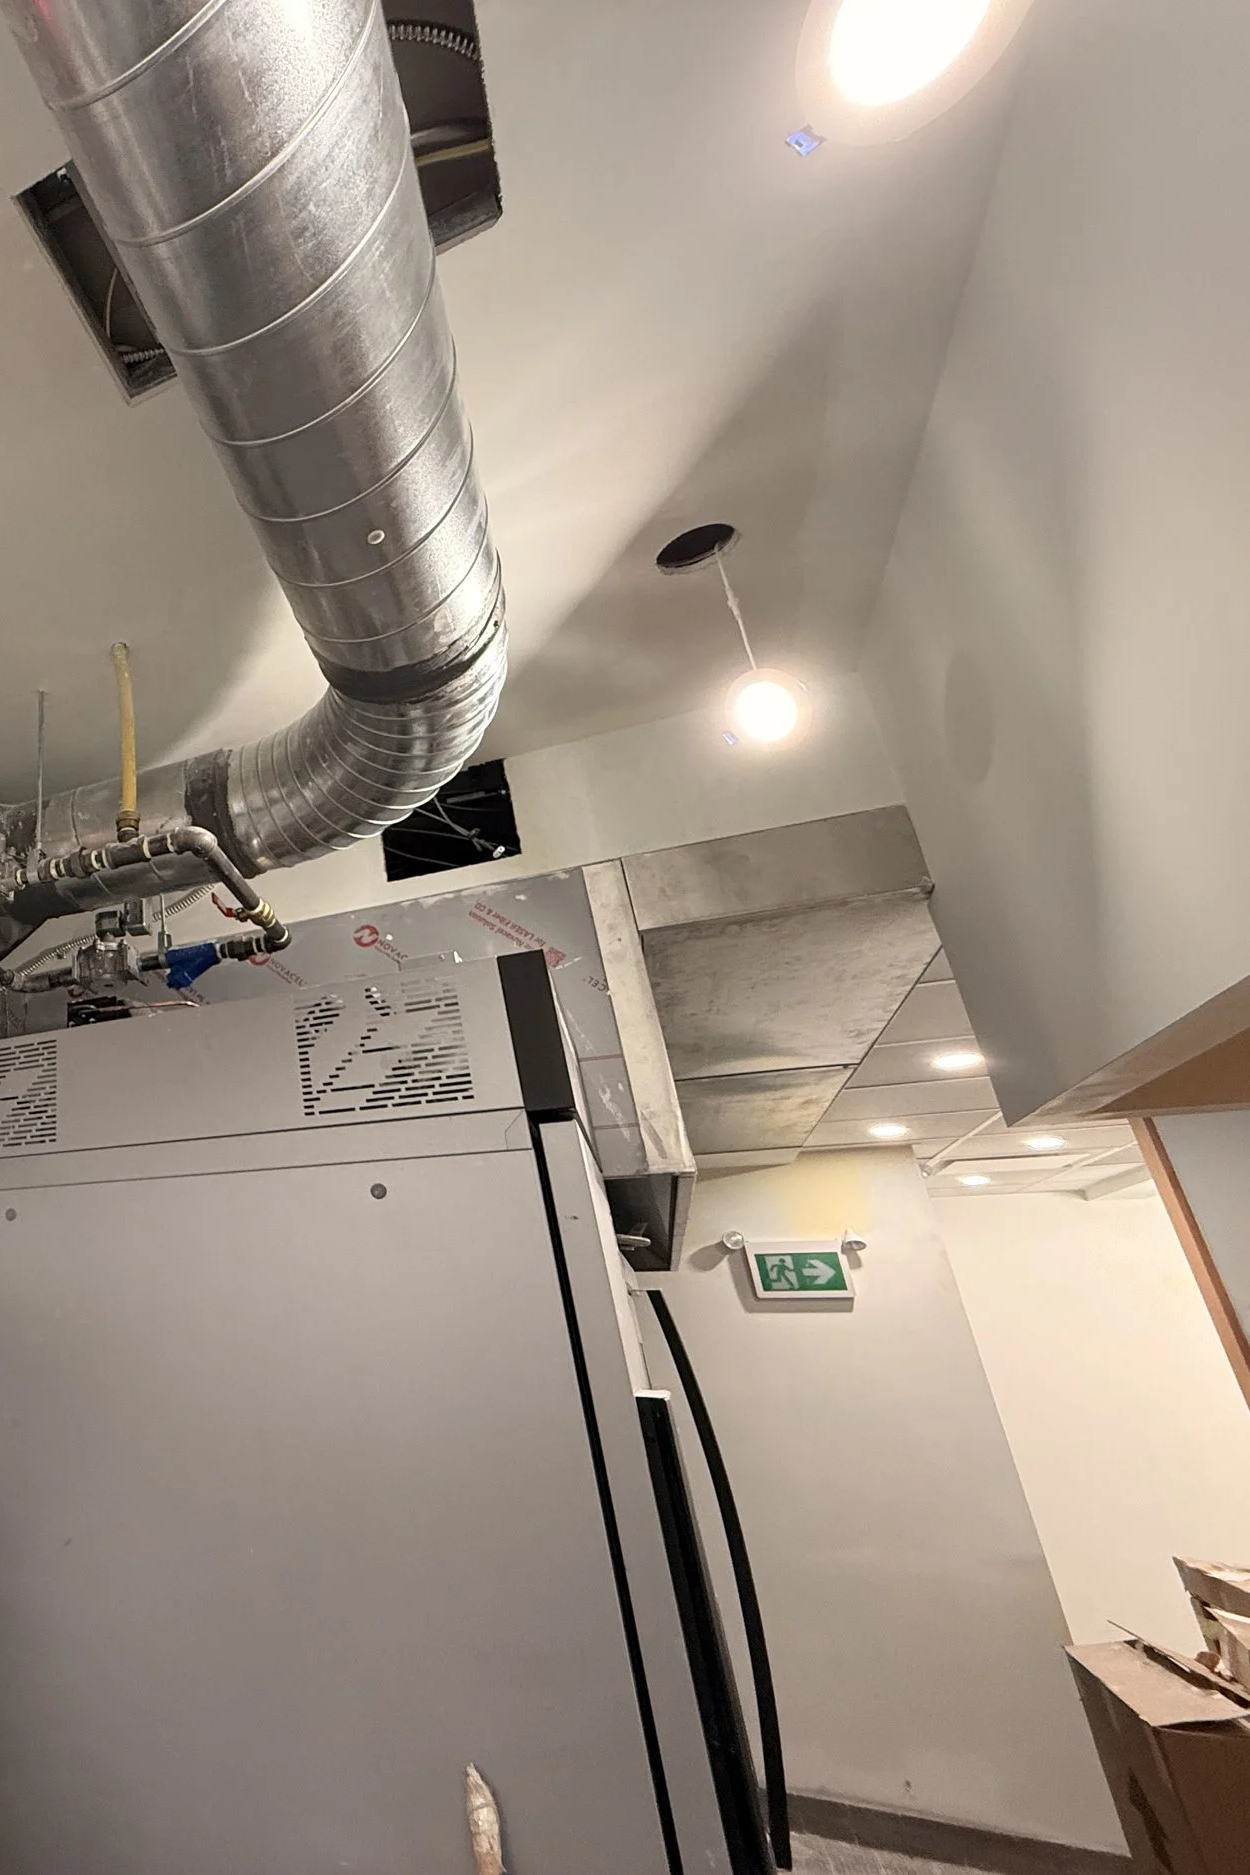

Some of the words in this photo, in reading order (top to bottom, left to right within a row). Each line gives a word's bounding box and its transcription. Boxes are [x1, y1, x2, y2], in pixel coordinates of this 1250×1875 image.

[468, 910, 496, 930] Solution
[509, 920, 536, 941] LASER
[378, 939, 408, 961] NOVAC
[270, 958, 304, 987] NOVACEL
